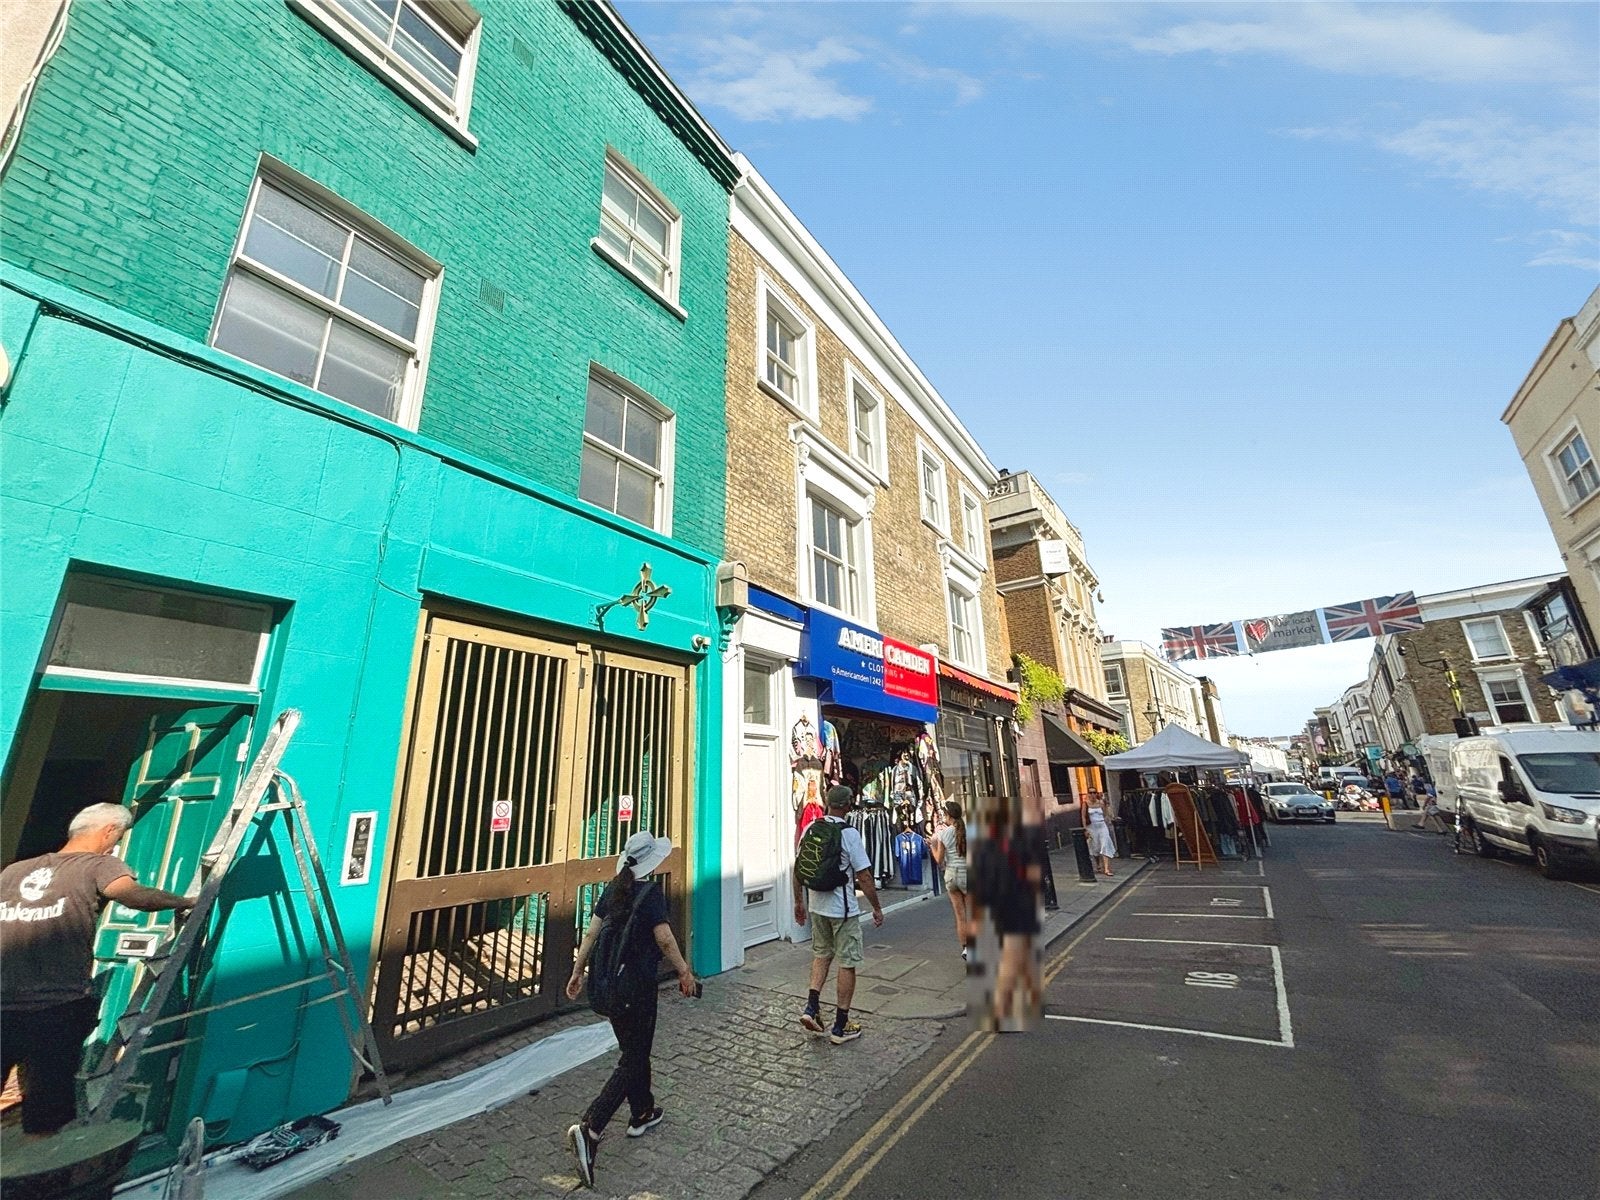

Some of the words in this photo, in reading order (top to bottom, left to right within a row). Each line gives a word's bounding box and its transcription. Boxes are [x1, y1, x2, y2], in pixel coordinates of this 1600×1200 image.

[1293, 616, 1313, 625] local
[1273, 625, 1317, 638] market
[885, 645, 930, 675] CAMDEN
